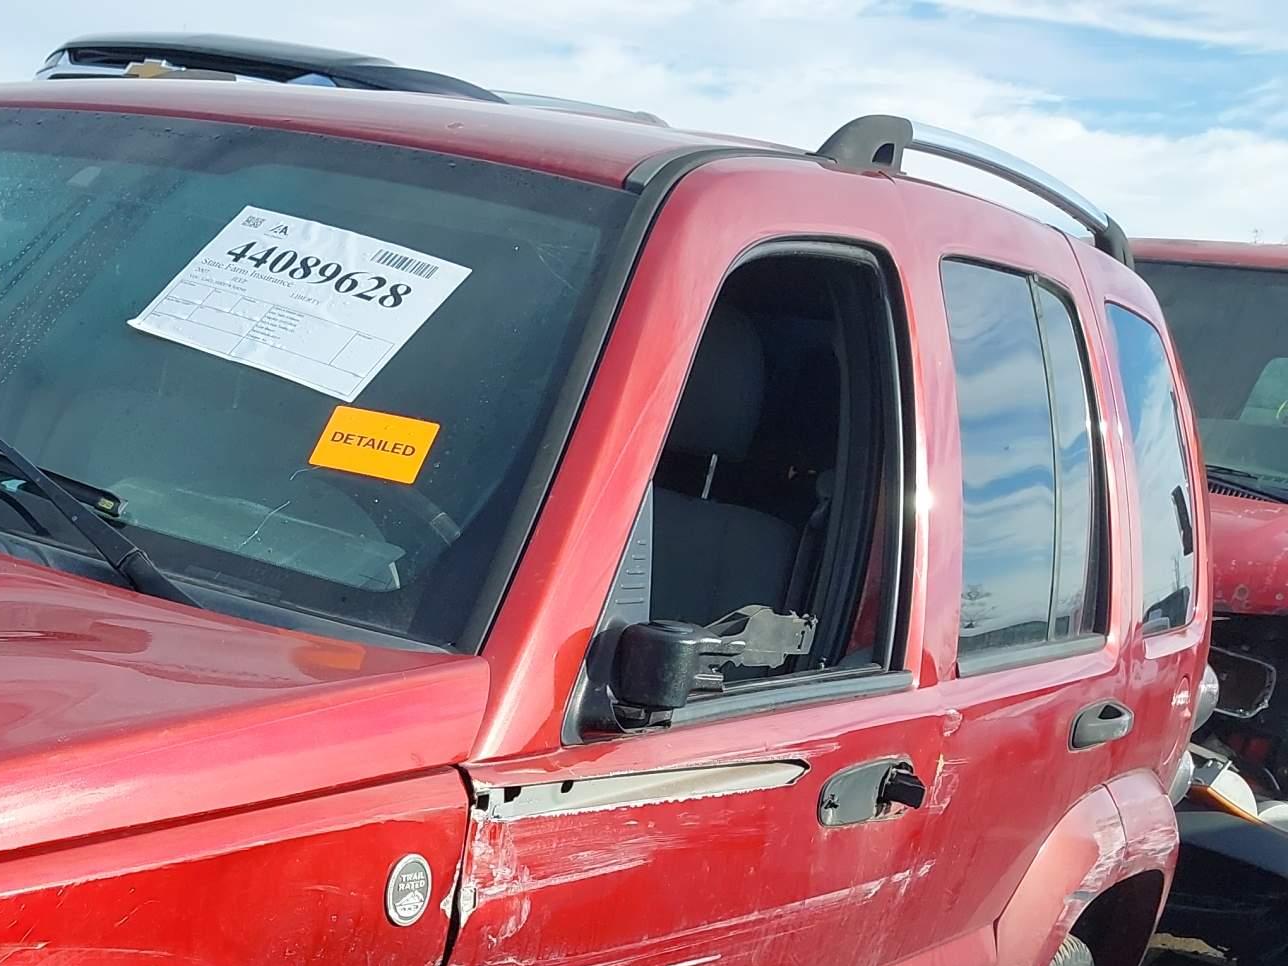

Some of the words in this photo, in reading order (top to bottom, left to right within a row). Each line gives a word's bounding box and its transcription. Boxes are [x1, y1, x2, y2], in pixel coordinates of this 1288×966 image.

[200, 256, 225, 270] State
[224, 262, 249, 276] Farm
[249, 269, 295, 289] Insurance
[226, 240, 412, 310] 44089628
[330, 430, 417, 459] DETAILED
[398, 881, 426, 892] RATED
[400, 872, 425, 883] TRAIL
